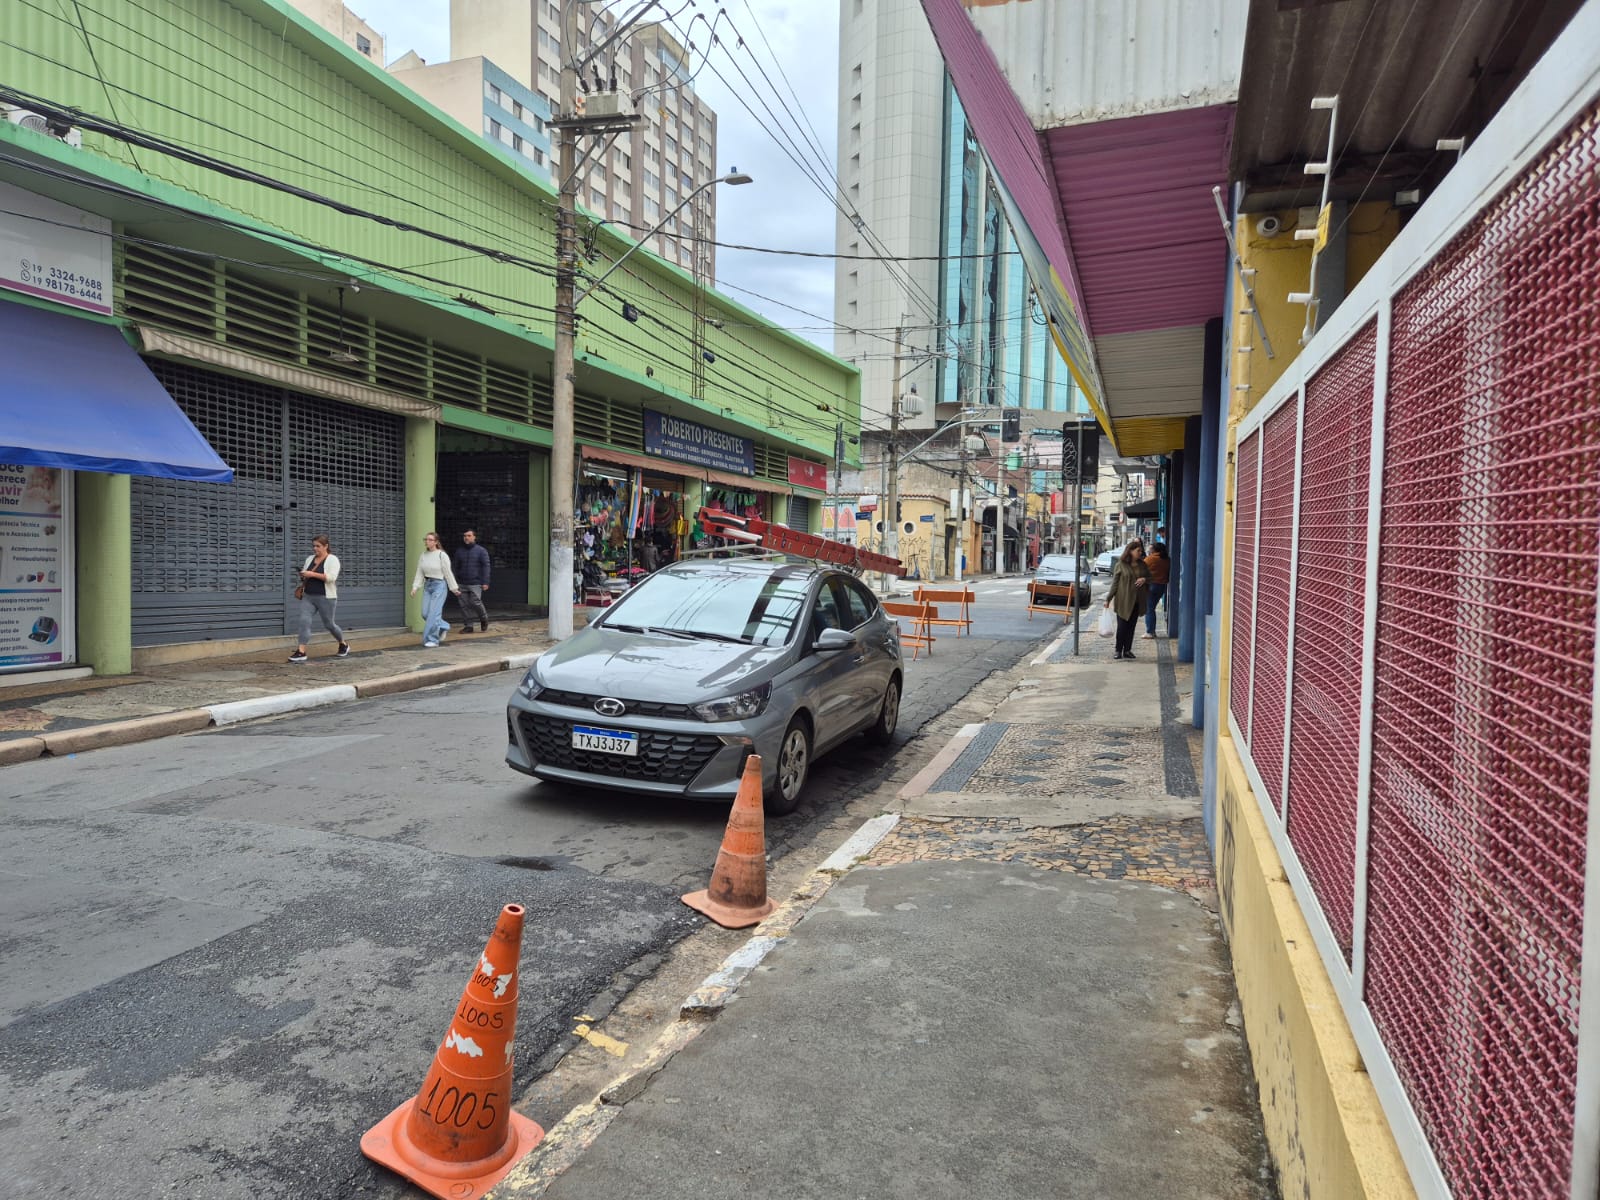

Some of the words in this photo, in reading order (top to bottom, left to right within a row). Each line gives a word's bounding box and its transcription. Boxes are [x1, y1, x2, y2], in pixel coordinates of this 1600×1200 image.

[33, 264, 42, 273] 19
[50, 267, 102, 290] 3324-9688
[33, 276, 42, 285] 19
[45, 279, 102, 301] 98178-6444
[661, 416, 701, 443] ROBERTO
[702, 428, 743, 455] PRESENTES
[579, 734, 631, 752] TXJ3J37
[472, 969, 499, 992] 1005
[459, 1001, 503, 1029] 1005
[420, 1077, 499, 1130] 1005
